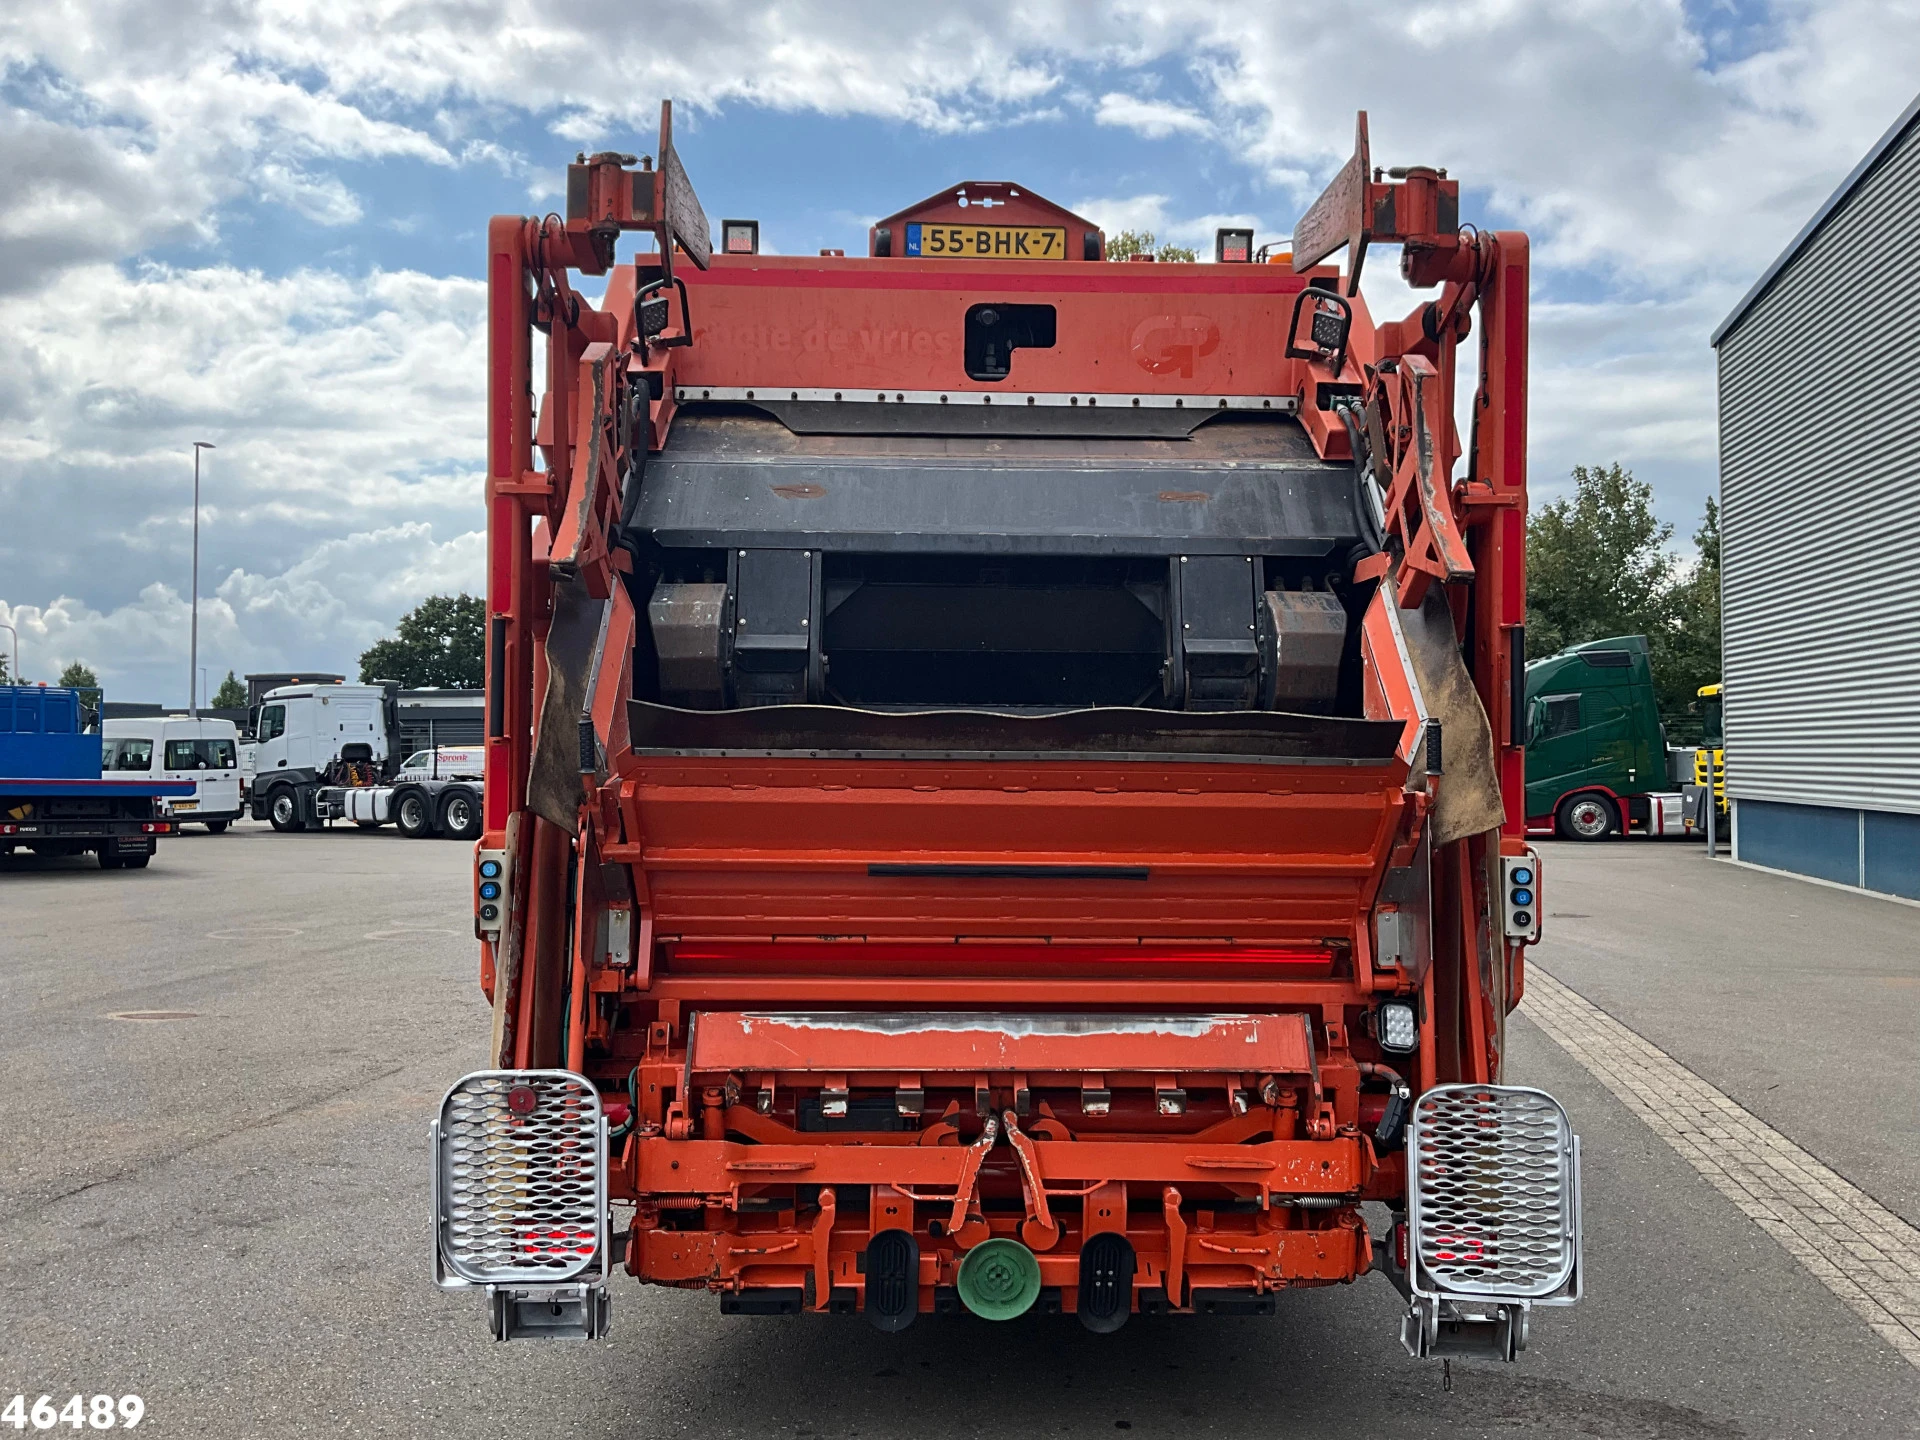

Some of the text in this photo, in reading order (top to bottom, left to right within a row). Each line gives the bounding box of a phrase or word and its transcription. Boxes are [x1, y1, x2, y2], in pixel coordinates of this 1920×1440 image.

[930, 229, 1056, 255] 55-BHK-7
[1131, 316, 1221, 379] GP
[438, 753, 468, 762] Spronk
